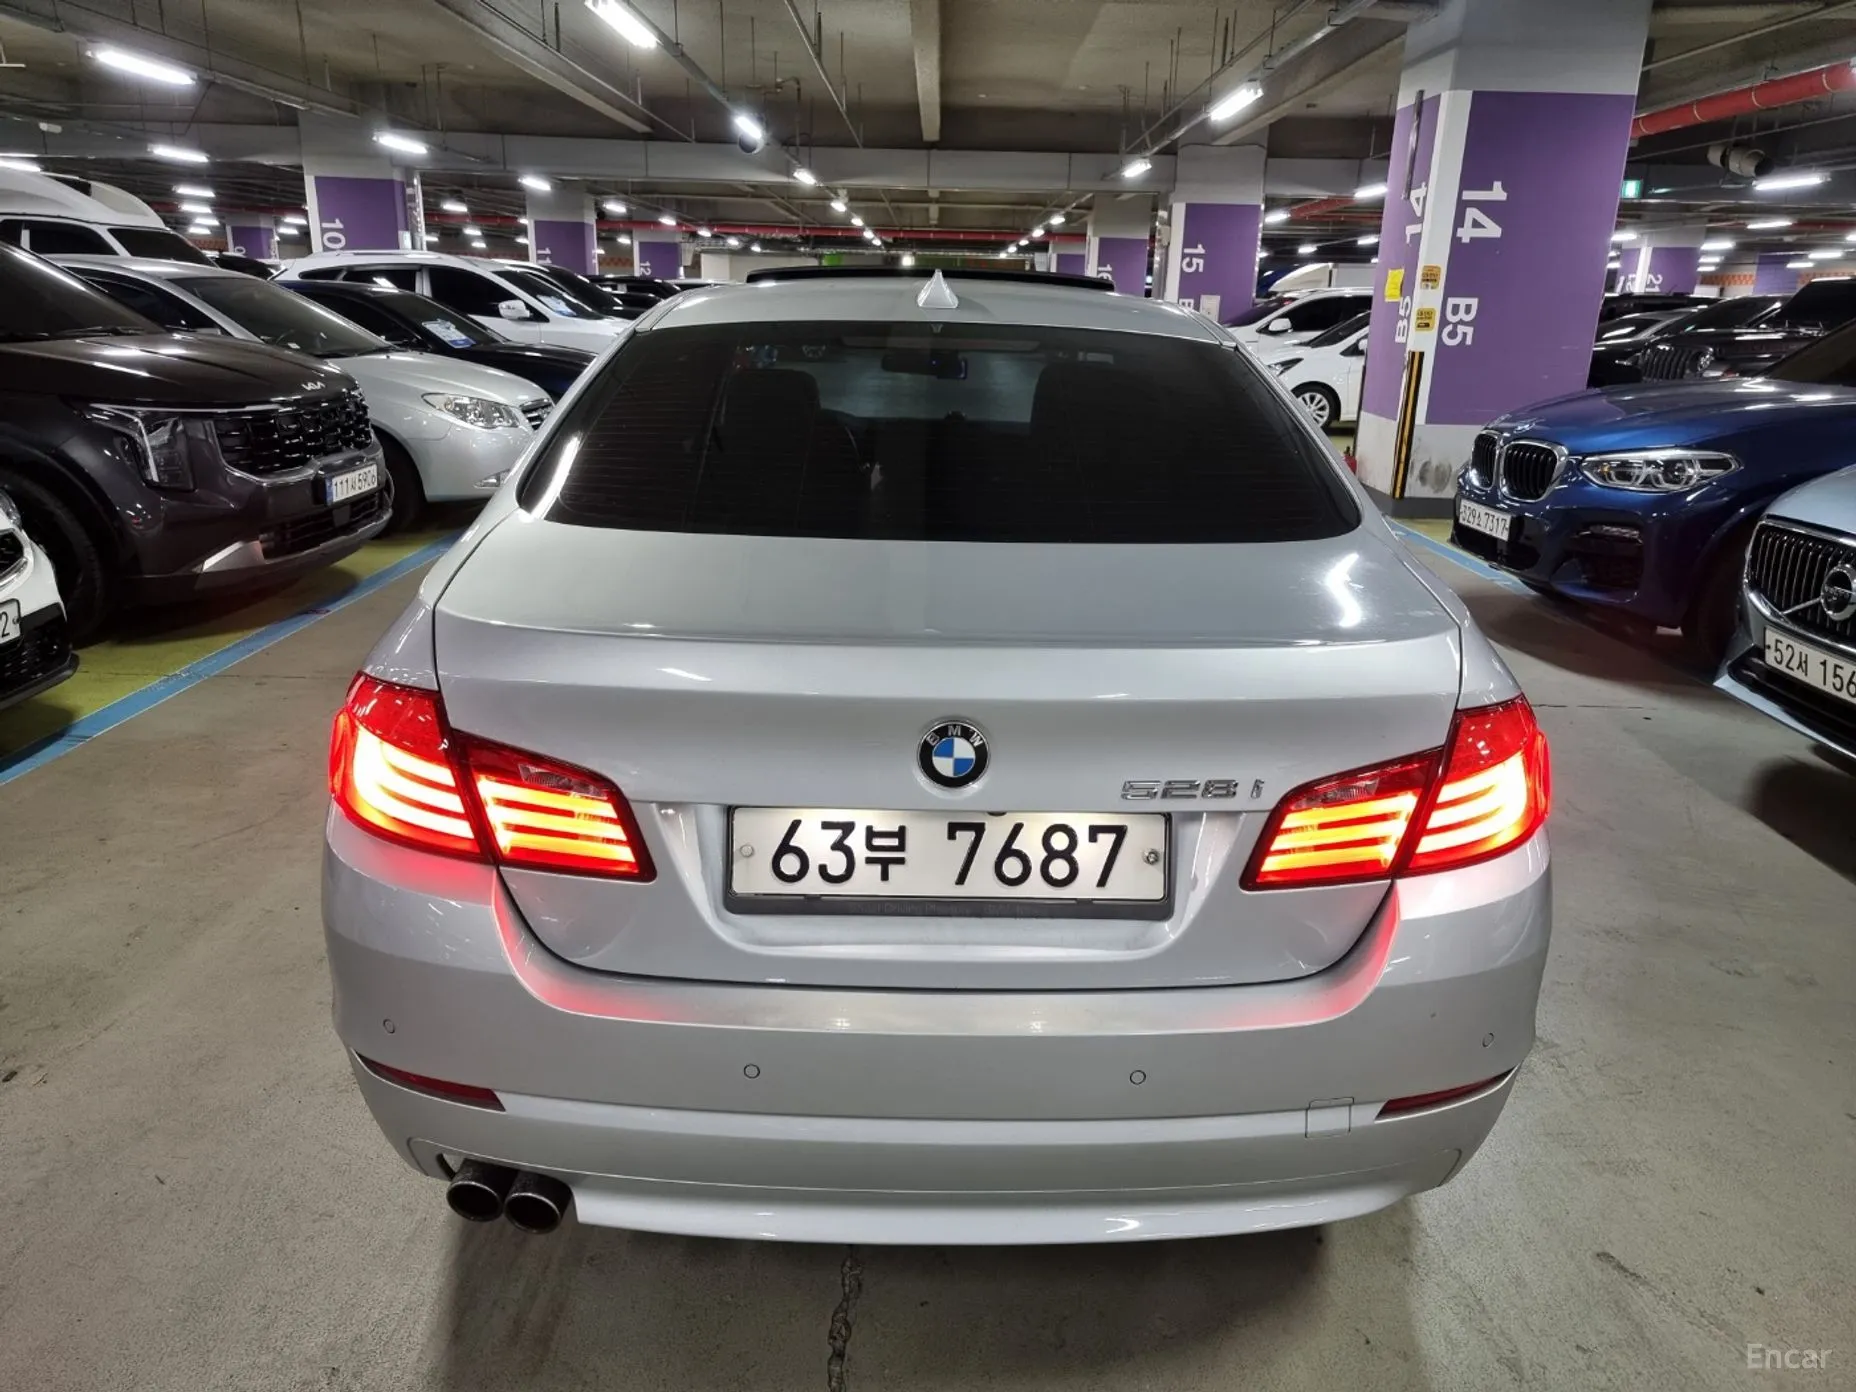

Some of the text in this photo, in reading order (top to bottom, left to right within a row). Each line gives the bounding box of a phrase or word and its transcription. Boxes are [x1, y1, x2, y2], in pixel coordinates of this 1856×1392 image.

[1456, 181, 1508, 243] 14
[321, 218, 346, 249] 10
[639, 261, 651, 275] 12
[1182, 244, 1205, 273] 15
[1395, 296, 1411, 343] B5
[1442, 297, 1478, 346] B5
[1774, 638, 1808, 677] 52서
[926, 725, 983, 747] BMW
[771, 819, 1128, 888] 63부 7687
